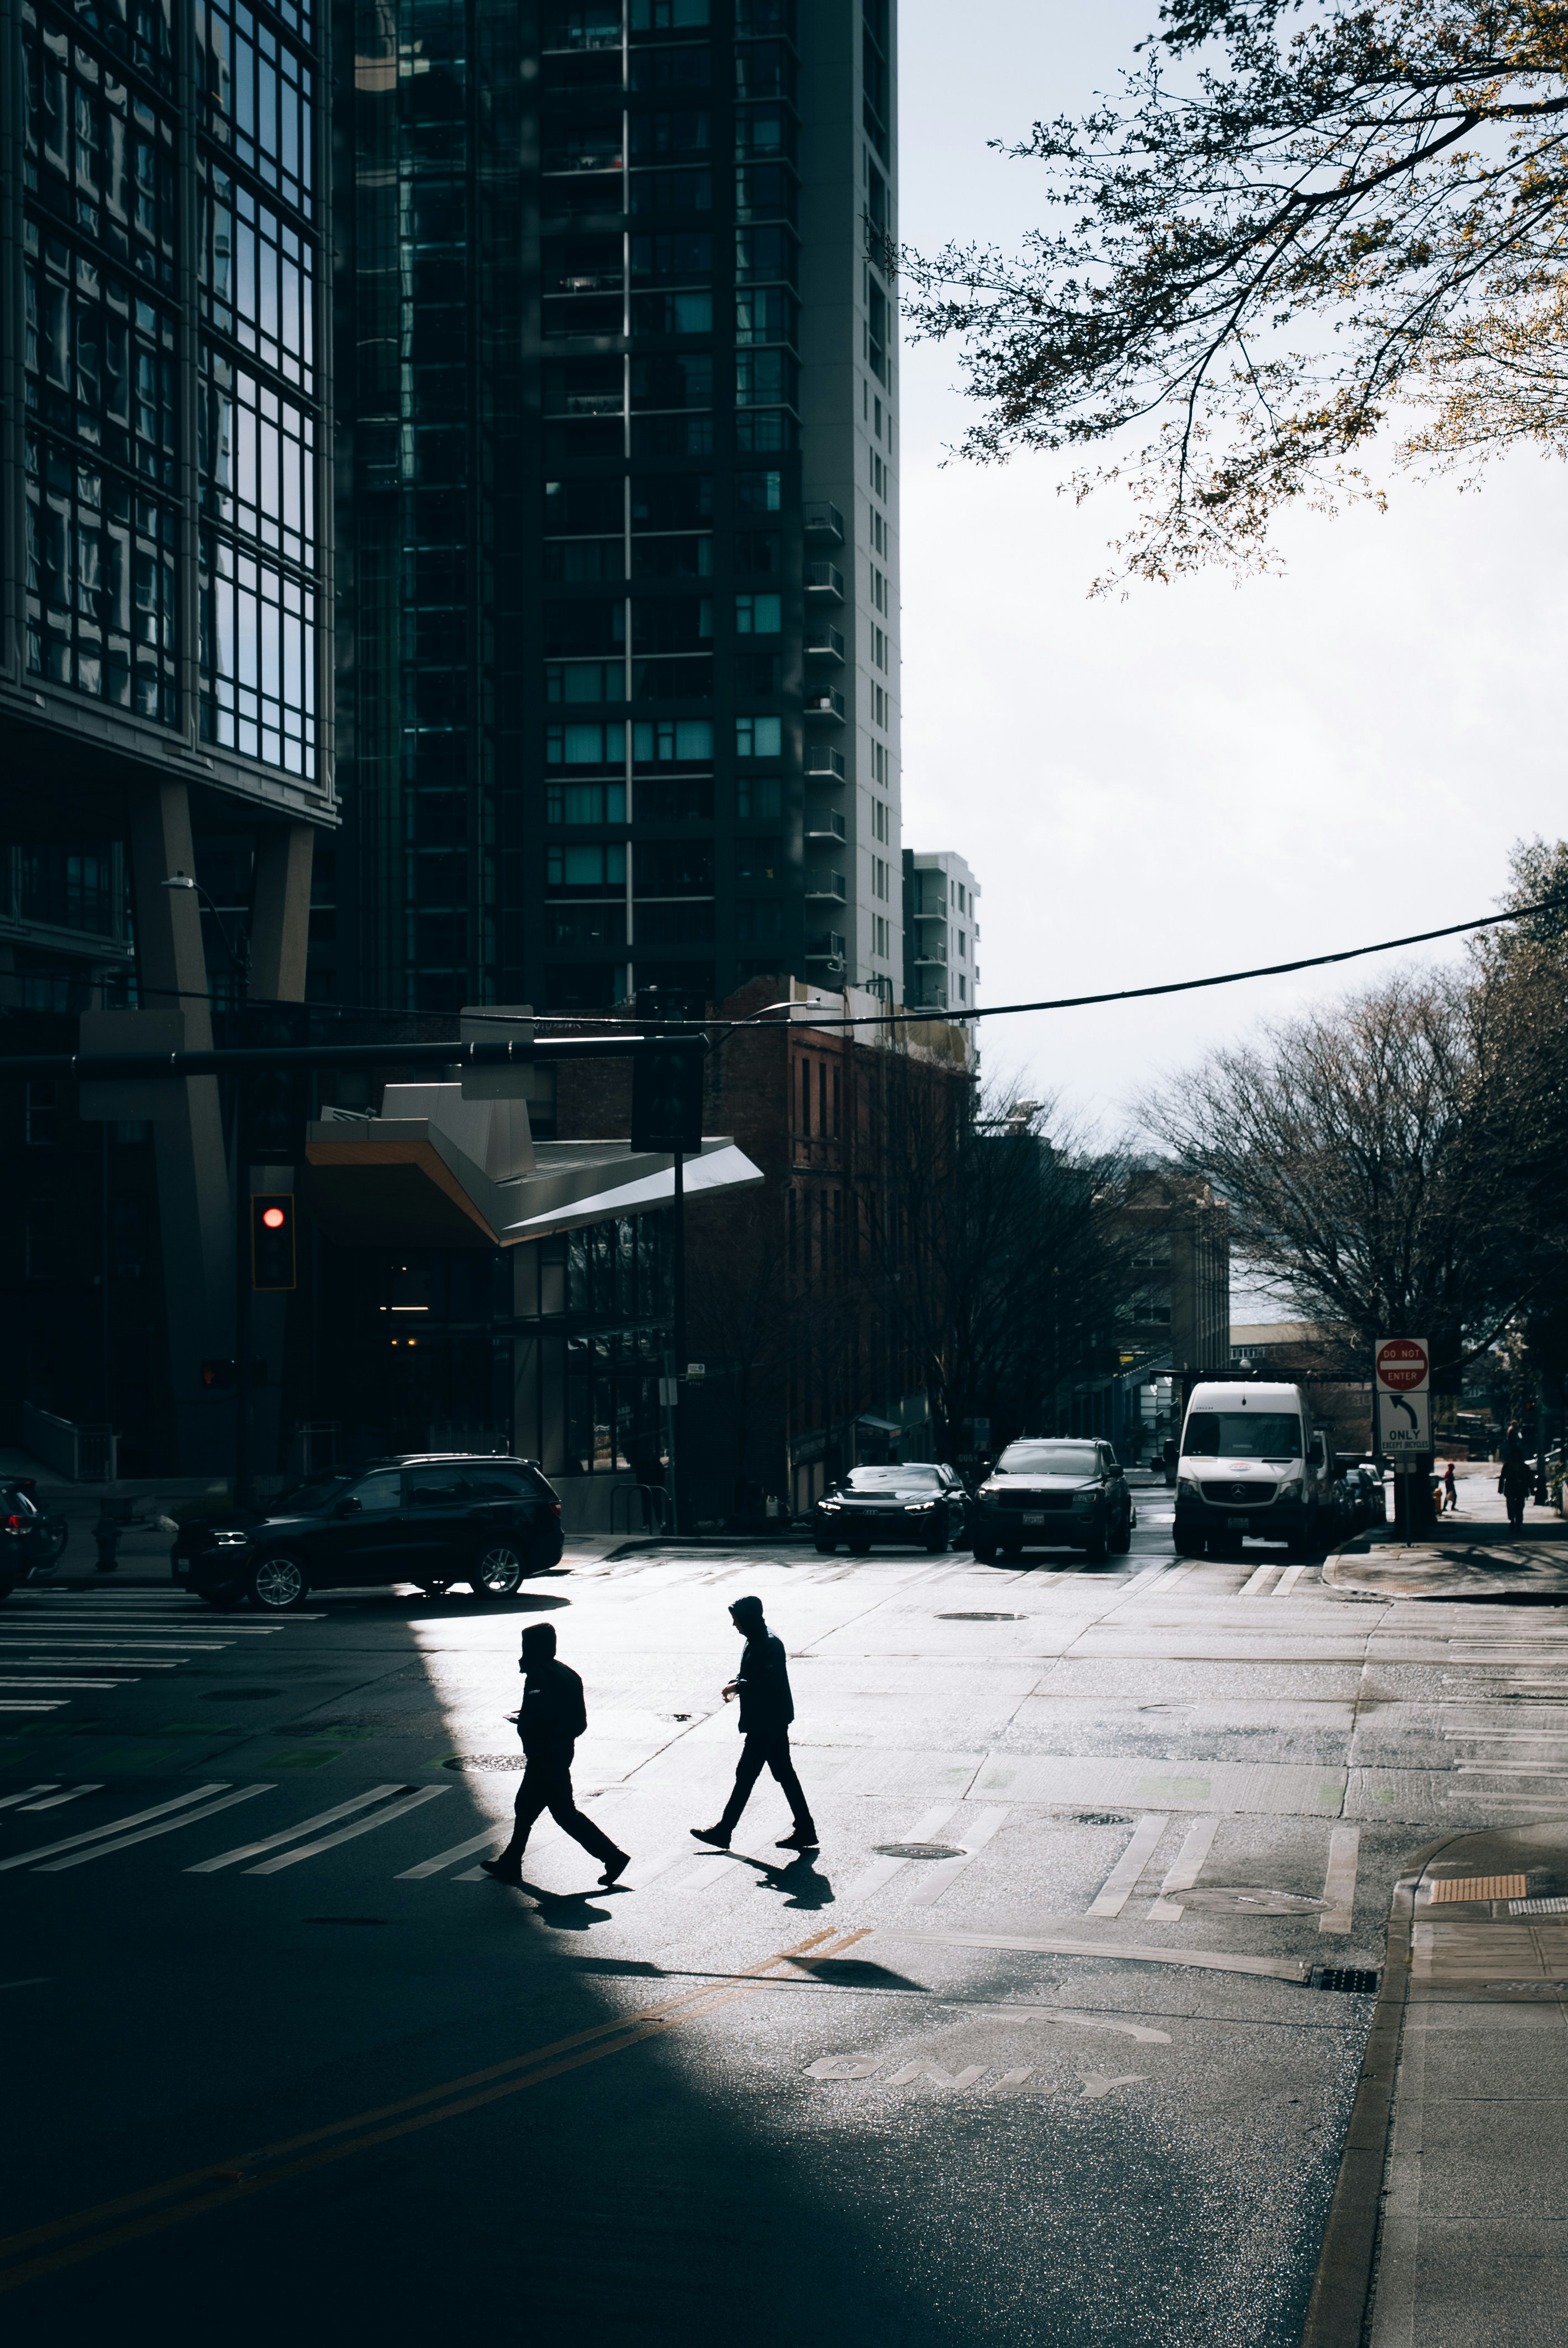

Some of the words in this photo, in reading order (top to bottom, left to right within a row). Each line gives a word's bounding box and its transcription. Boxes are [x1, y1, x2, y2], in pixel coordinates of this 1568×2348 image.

[1388, 1372, 1417, 1381] ENTER
[1389, 1430, 1420, 1440] ONLY
[802, 2054, 1153, 2098] ONLY
